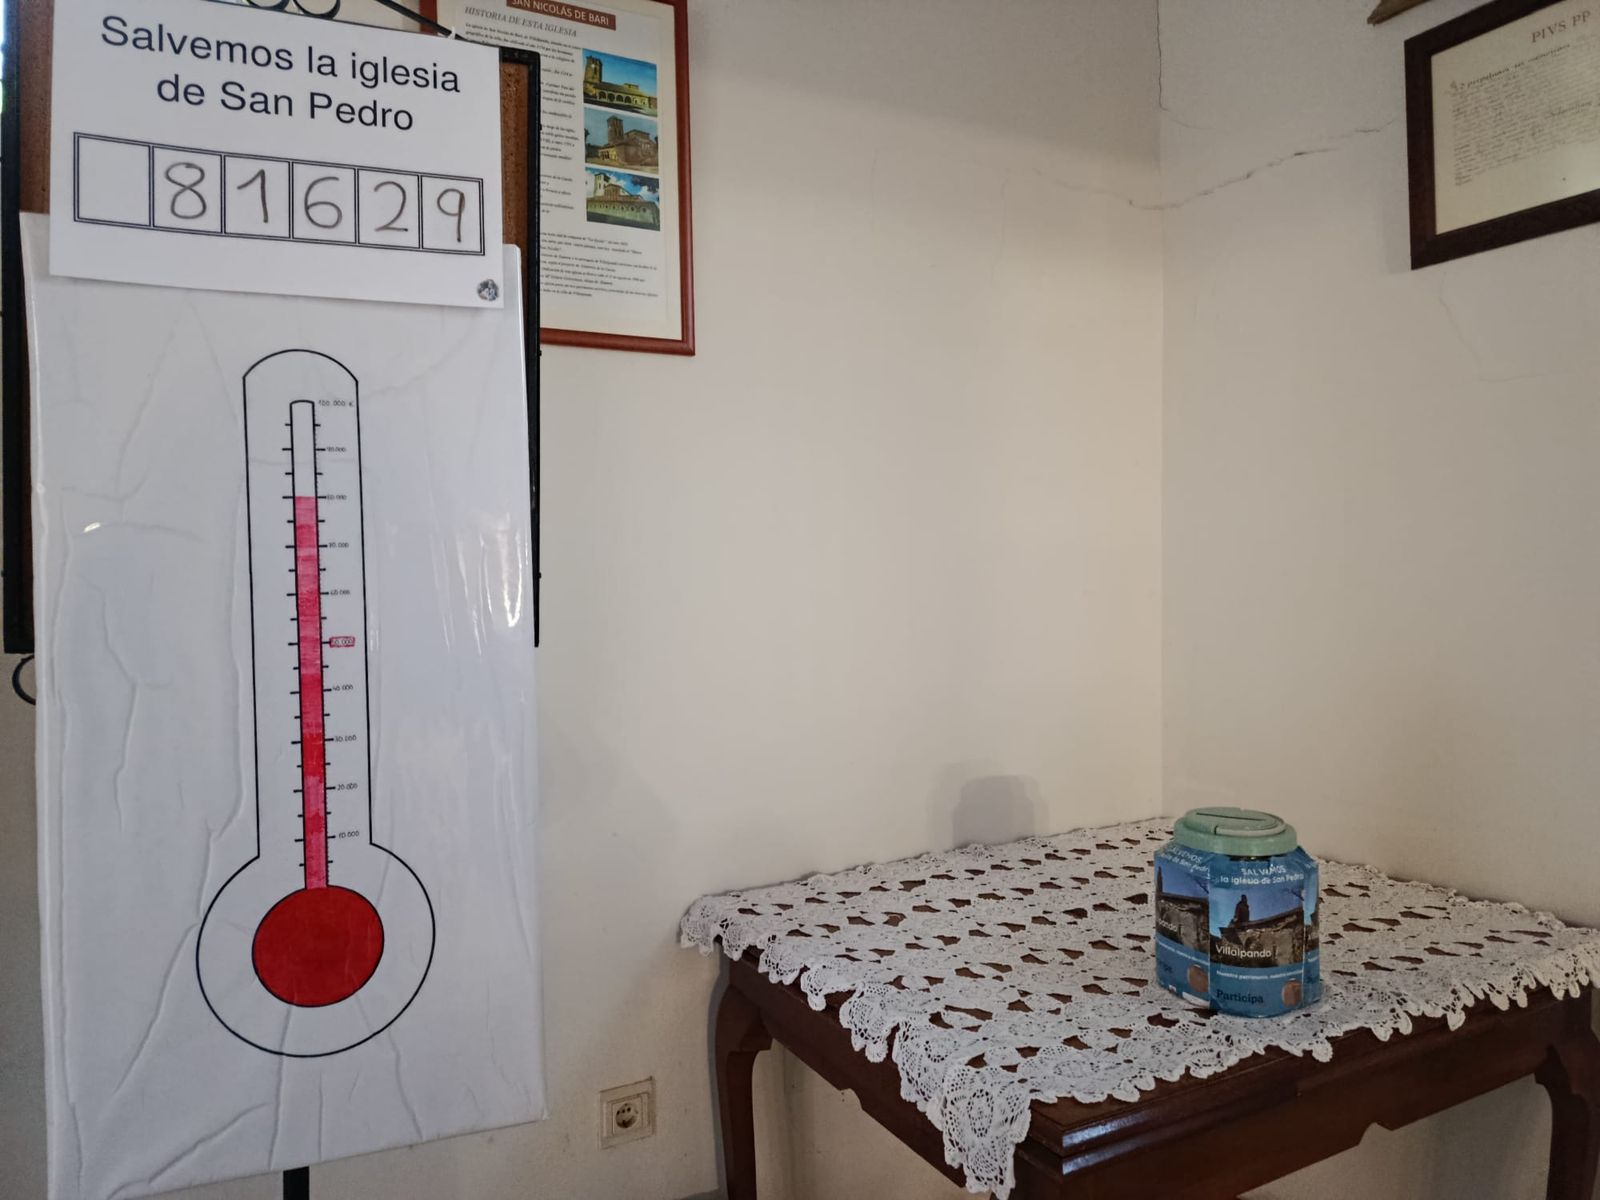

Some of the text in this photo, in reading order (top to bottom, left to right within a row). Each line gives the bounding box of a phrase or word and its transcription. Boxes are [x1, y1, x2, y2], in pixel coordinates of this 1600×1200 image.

[464, 6, 507, 21] HISTORIA
[508, 16, 520, 24] DE
[521, 18, 543, 31] ESTA
[544, 23, 577, 37] IGLESIA
[533, 1, 573, 18] NICOLÁS
[574, 10, 587, 20] DE
[588, 13, 609, 26] BARI
[101, 15, 461, 93] Salvemos la iglesia
[156, 74, 413, 131] de San Pedro
[1215, 944, 1272, 959] Villalpando
[1216, 989, 1264, 1005] Participa
